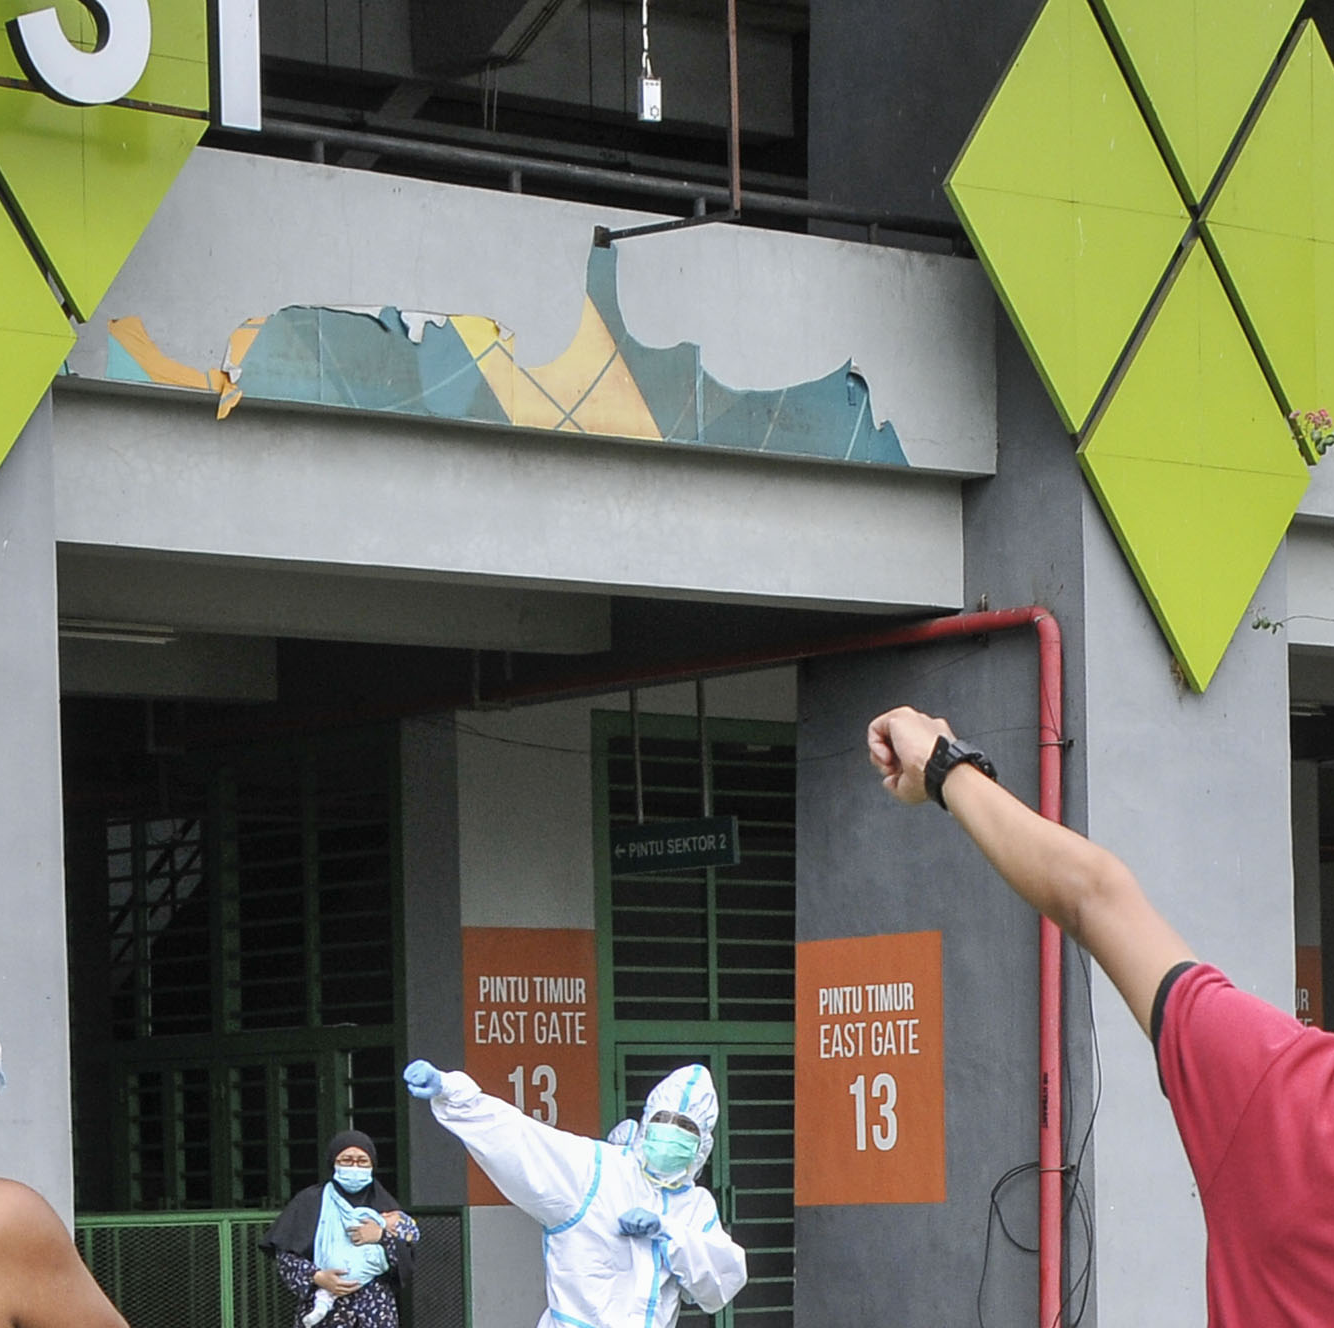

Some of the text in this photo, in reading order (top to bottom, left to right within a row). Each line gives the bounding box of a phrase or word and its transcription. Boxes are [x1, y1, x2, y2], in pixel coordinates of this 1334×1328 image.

[629, 833, 727, 858] PINTU SEKTOR 2
[478, 976, 586, 1004] PINTU TIMUR
[819, 982, 915, 1016] PINTU TIMUR
[474, 1010, 587, 1045] EAST GATE
[819, 1018, 920, 1059] EAST GATE
[508, 1064, 558, 1128] 13
[849, 1072, 898, 1151] 13
